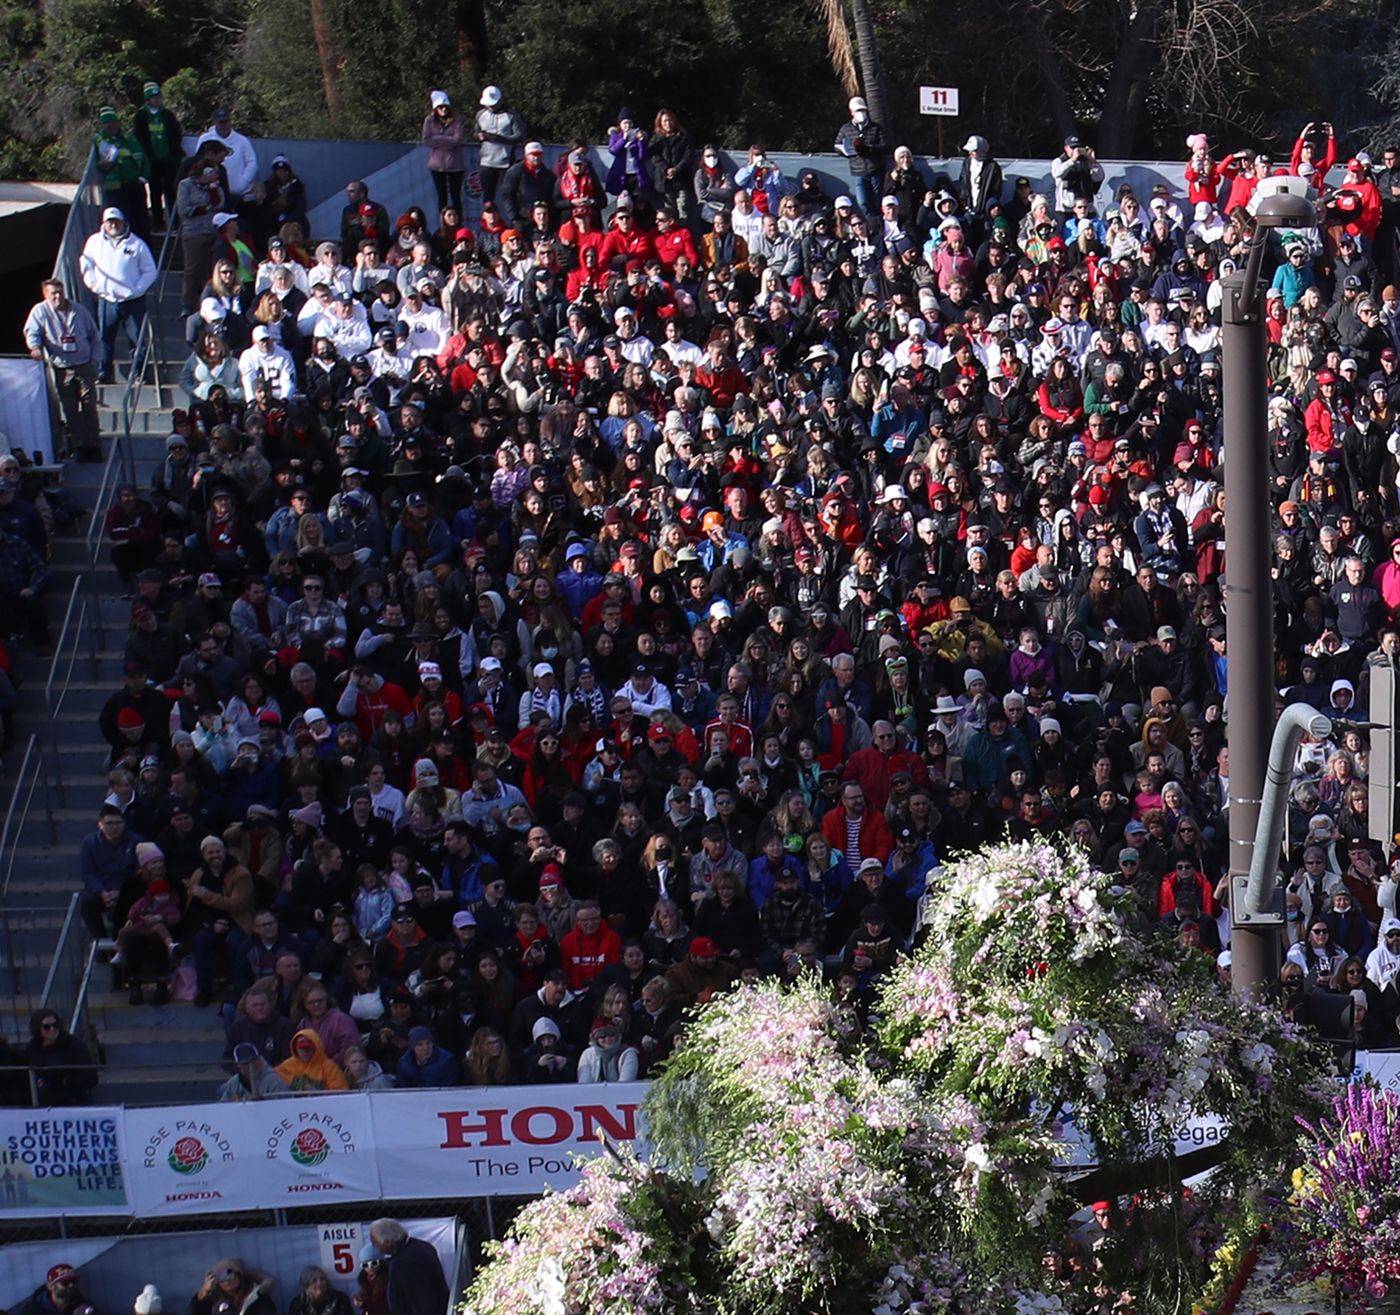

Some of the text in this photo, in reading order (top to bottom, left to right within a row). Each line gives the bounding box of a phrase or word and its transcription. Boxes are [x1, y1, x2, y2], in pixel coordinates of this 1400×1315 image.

[931, 90, 947, 105] 11
[25, 1119, 116, 1135] HELPING
[437, 1104, 638, 1149] HON
[8, 1134, 117, 1150] SOUTHERN
[144, 1120, 235, 1168] ROSE PARADE
[266, 1112, 355, 1160] ROSE PARADE
[35, 1163, 121, 1178] DONATE
[468, 1158, 519, 1177] The
[287, 1182, 345, 1193] HONDA
[165, 1191, 223, 1202] HONDA
[323, 1228, 358, 1240] AISLE
[332, 1244, 355, 1275] 5
